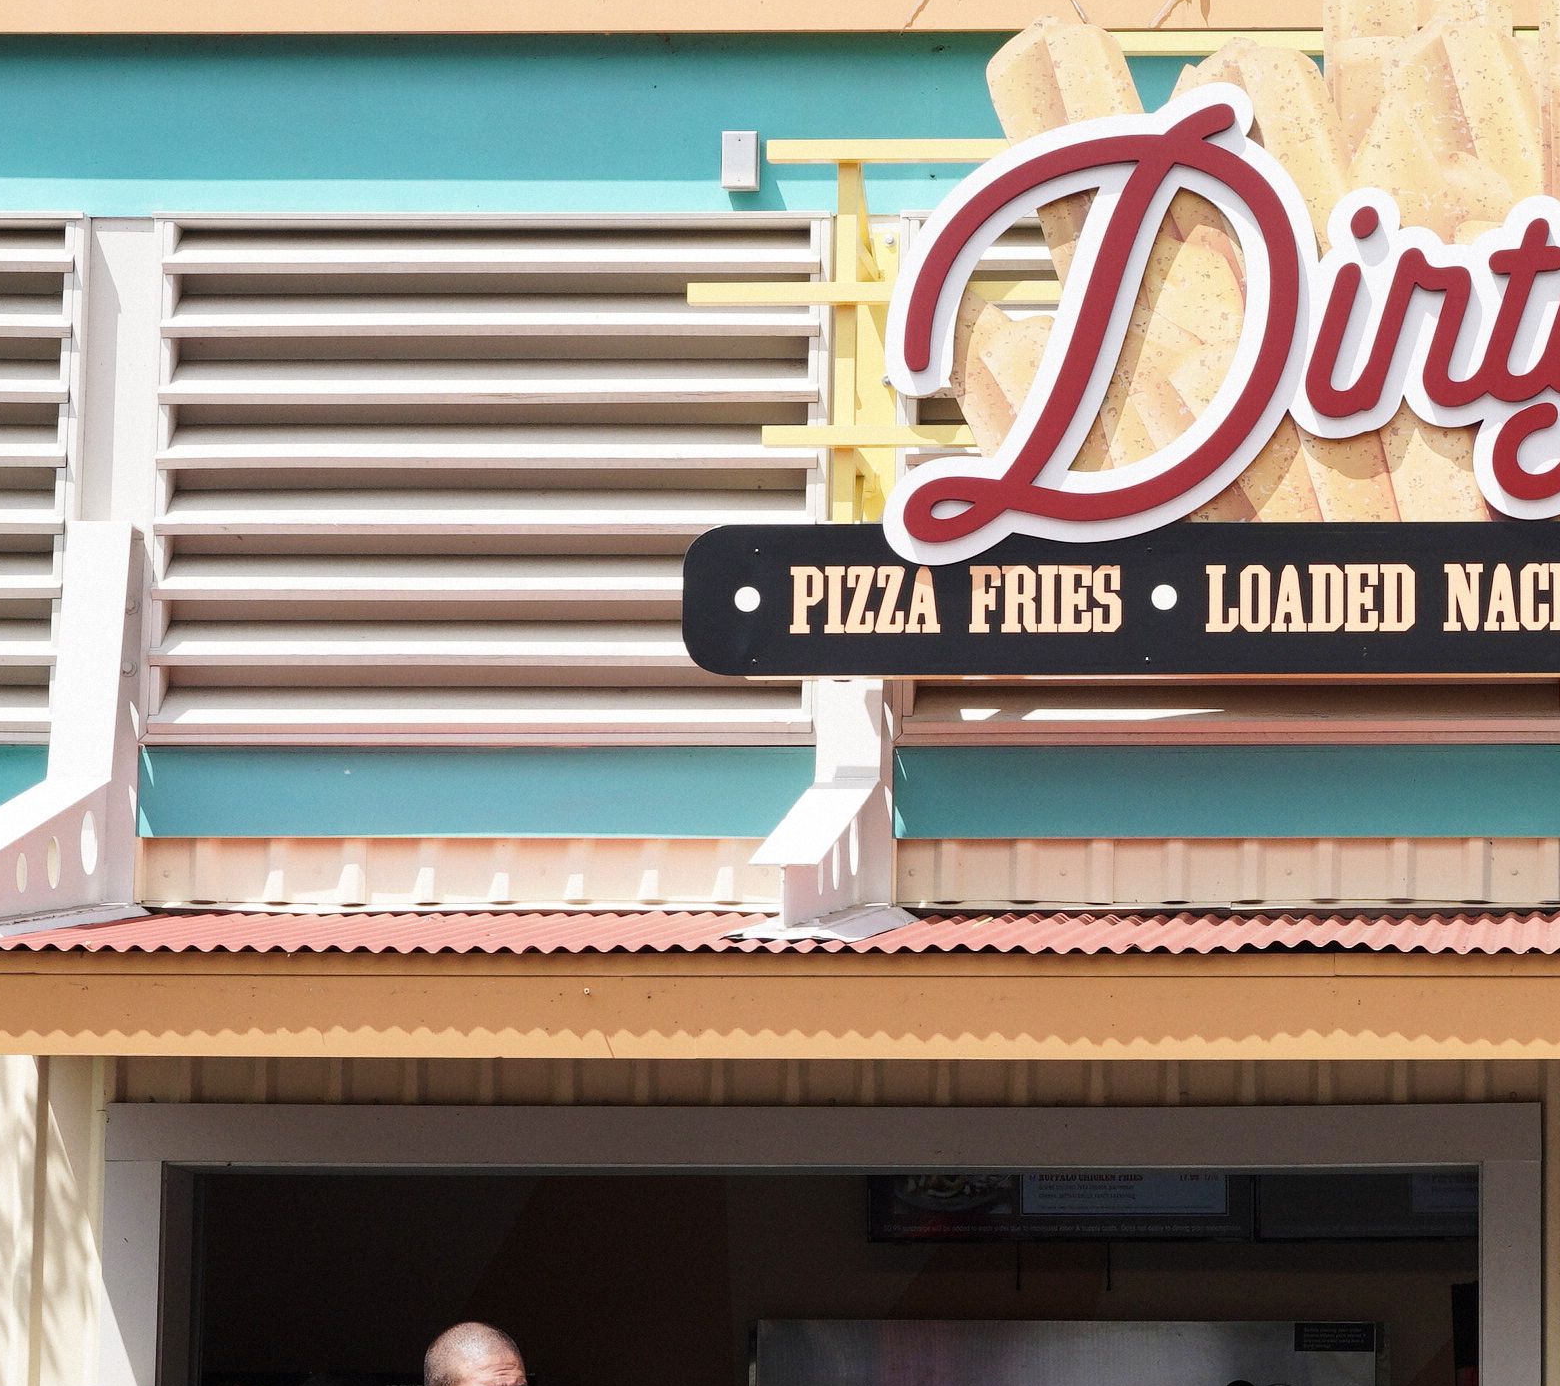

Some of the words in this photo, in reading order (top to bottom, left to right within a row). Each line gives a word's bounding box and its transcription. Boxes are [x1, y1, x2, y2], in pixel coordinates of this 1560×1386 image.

[788, 564, 937, 637] PIZZA
[969, 563, 1124, 635] FRIES
[1204, 562, 1418, 635] LOADED
